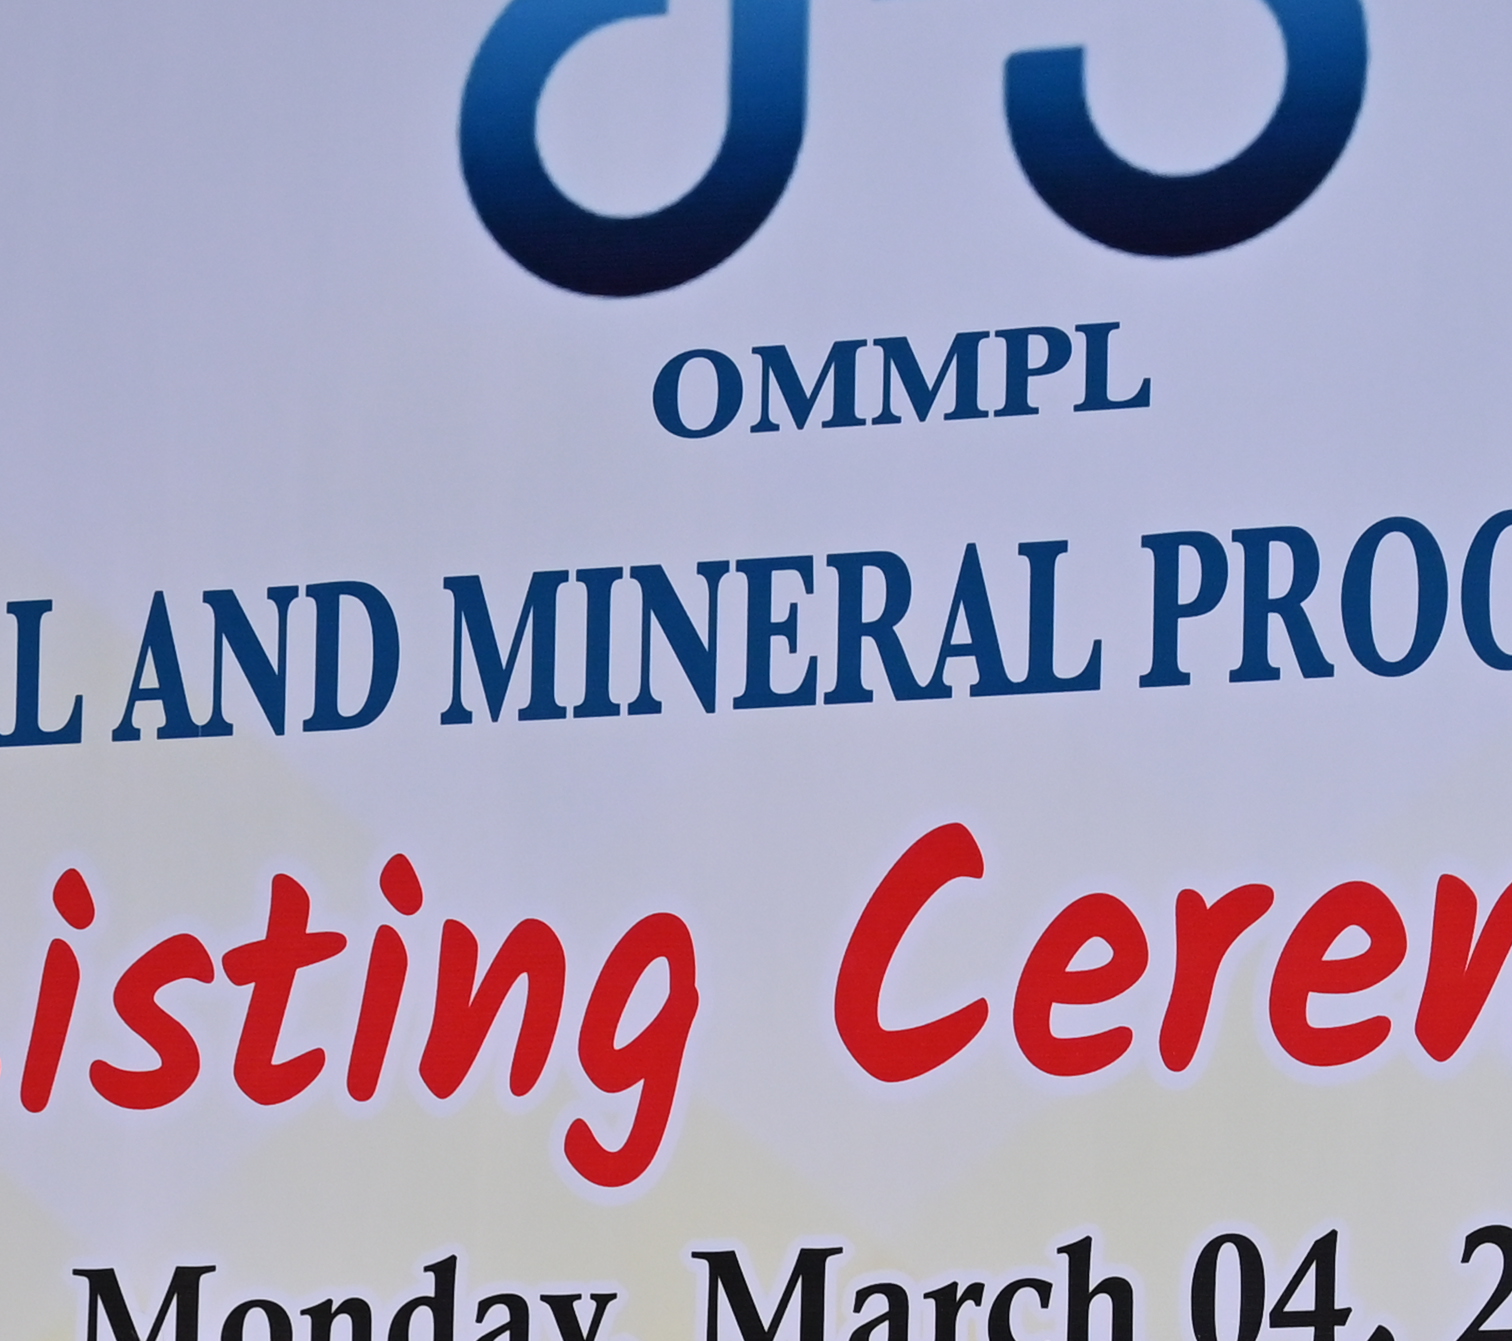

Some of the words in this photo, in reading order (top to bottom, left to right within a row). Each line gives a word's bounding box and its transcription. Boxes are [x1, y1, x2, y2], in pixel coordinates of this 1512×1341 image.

[653, 322, 1150, 438] OMMPL
[112, 581, 399, 742] AND
[441, 540, 1102, 725] MINERAL
